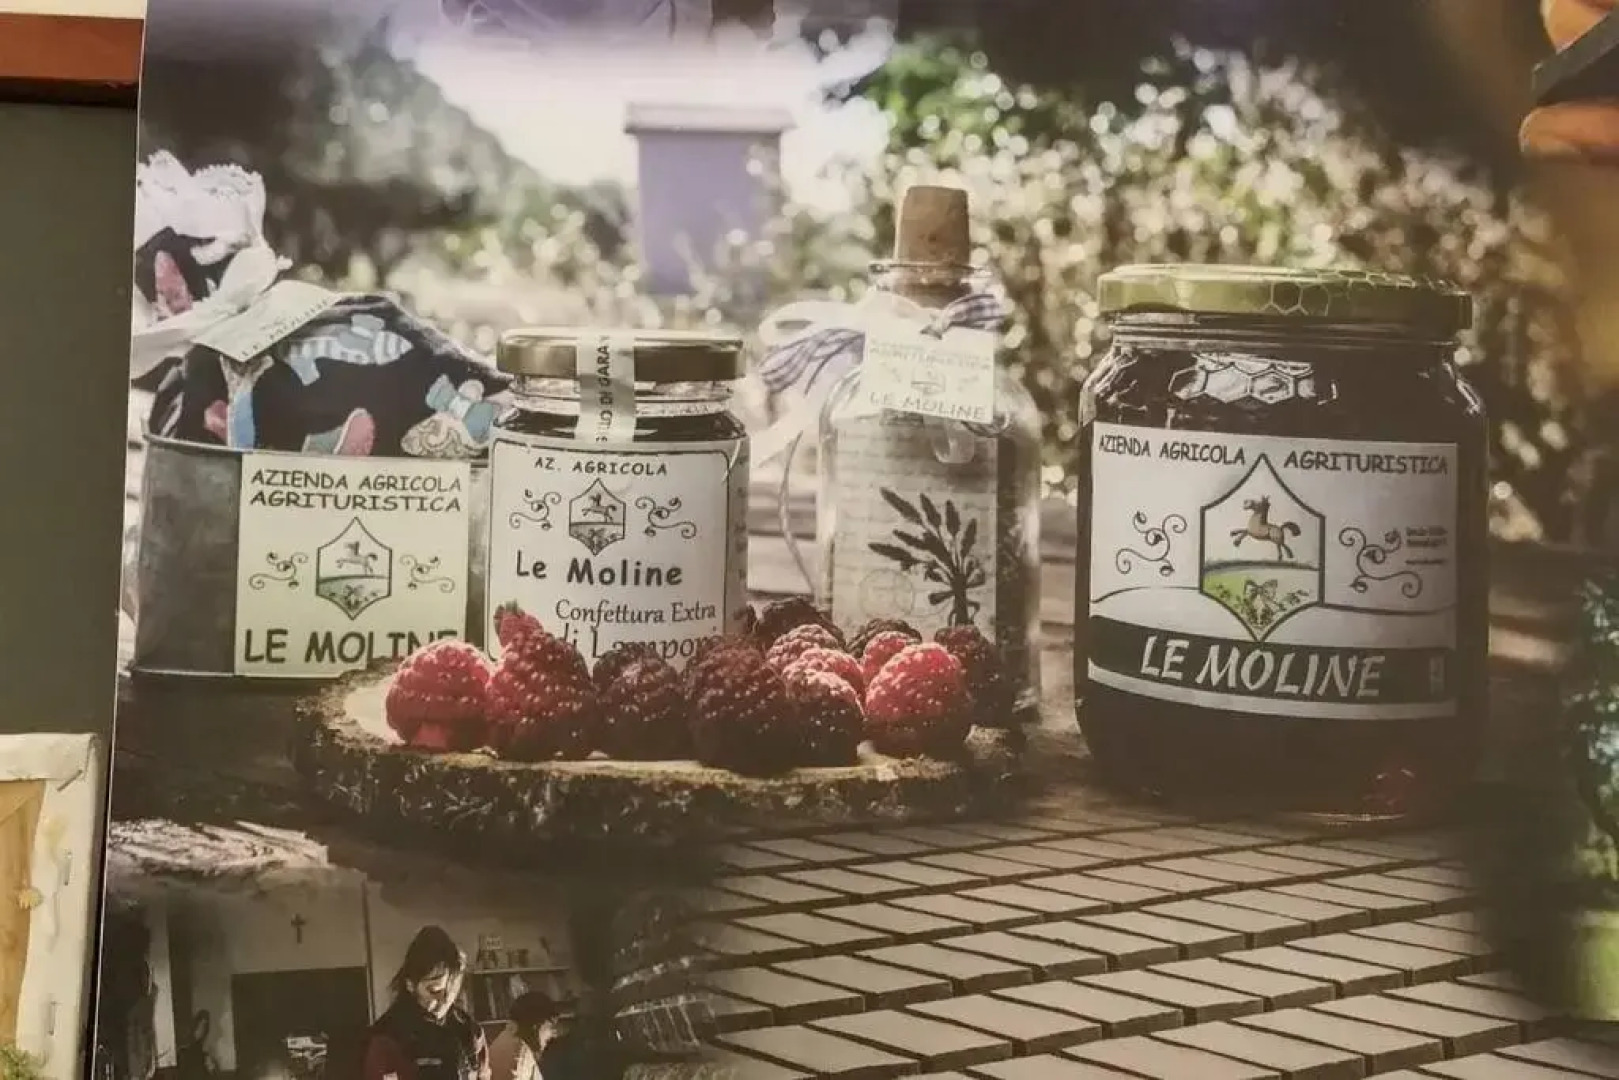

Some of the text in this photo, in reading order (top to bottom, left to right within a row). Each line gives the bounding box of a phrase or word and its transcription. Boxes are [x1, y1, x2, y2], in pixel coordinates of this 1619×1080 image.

[599, 391, 613, 406] DI
[901, 397, 985, 419] MOLINE
[534, 457, 667, 475] AZ. AGRICOLA
[1100, 435, 1448, 475] AZIENDA AGRICOLA AGRITURISTICA
[251, 469, 462, 492] AZIENDA AGRICOLA
[250, 490, 461, 512] AGRITURISTICA
[516, 550, 683, 586] Le Moline
[556, 599, 716, 627] Confettura Extra
[244, 628, 288, 664] LE
[1140, 635, 1189, 680] LE
[1195, 643, 1385, 698] MOLINE
